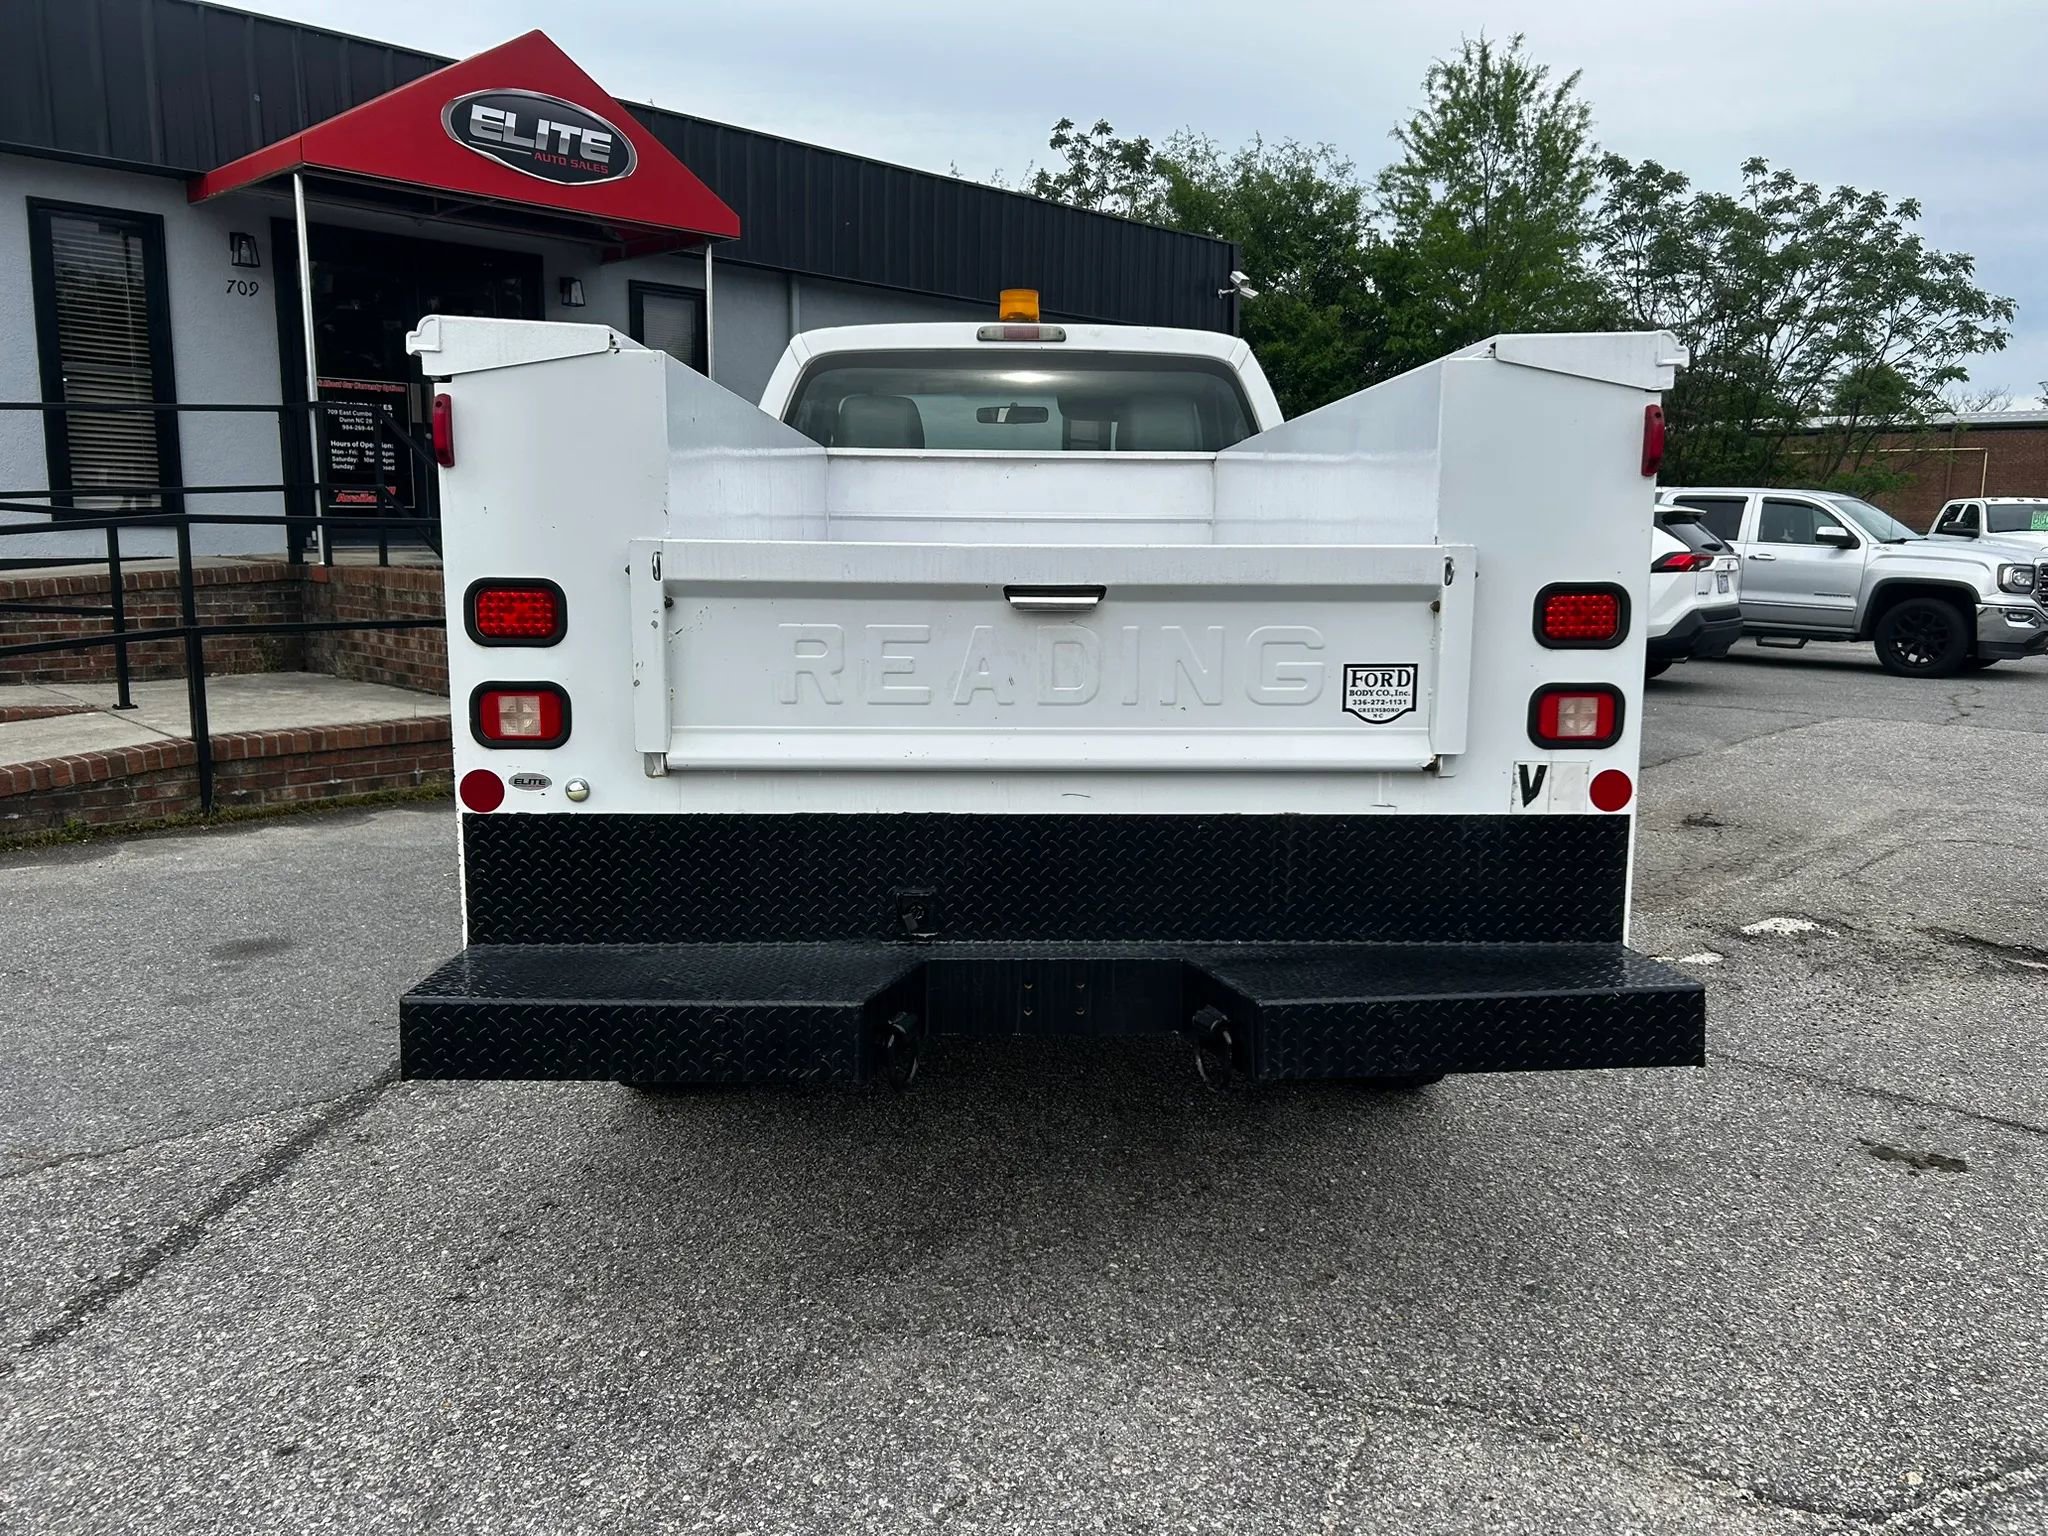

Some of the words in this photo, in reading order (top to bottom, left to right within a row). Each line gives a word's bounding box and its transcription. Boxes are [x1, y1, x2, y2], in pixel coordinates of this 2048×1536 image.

[469, 104, 612, 163] ELITE
[534, 152, 567, 167] AUTO
[570, 158, 609, 175] SALES
[226, 279, 259, 297] 709
[330, 440, 351, 448] Hours
[332, 463, 355, 471] Sunday:
[778, 623, 1327, 706] READING
[1350, 669, 1411, 688] FORD
[1349, 689, 1375, 697] BODY
[513, 778, 546, 786] ELITE
[1517, 764, 1549, 809] V
